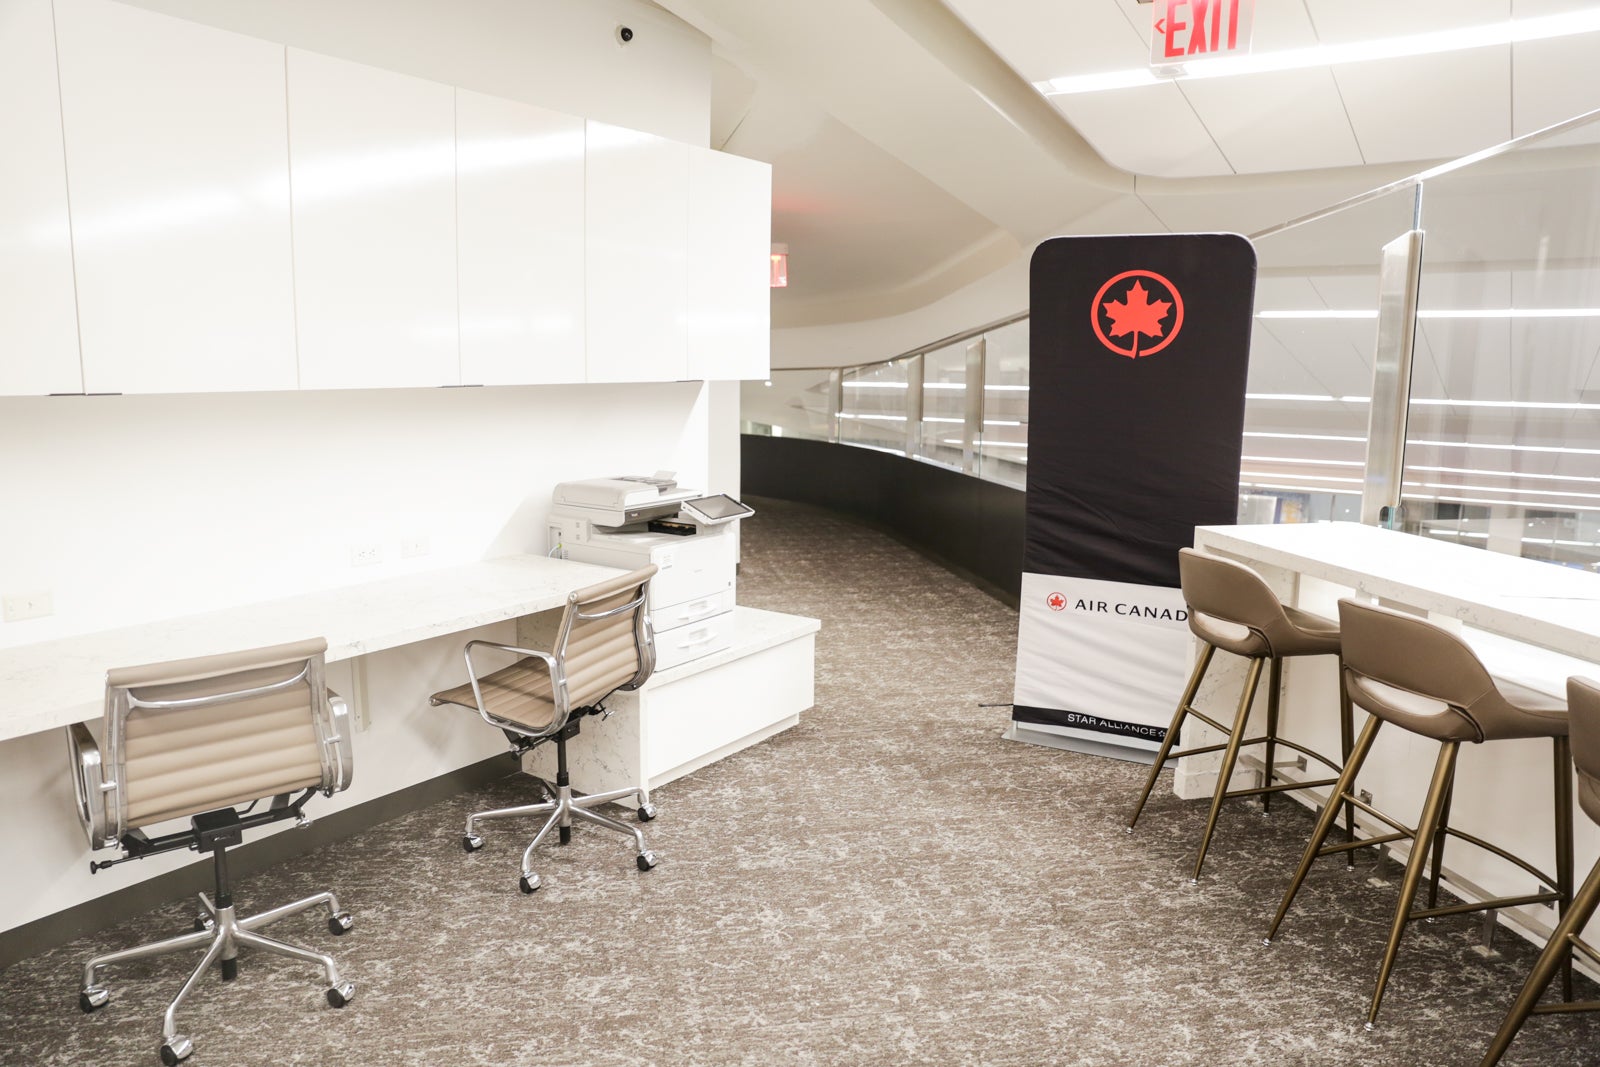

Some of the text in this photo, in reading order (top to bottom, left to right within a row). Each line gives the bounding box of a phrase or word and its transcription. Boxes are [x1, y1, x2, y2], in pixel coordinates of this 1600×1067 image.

[1075, 599, 1188, 622] AIR CANAD
[1067, 713, 1156, 737] STAR ALLIANCE
